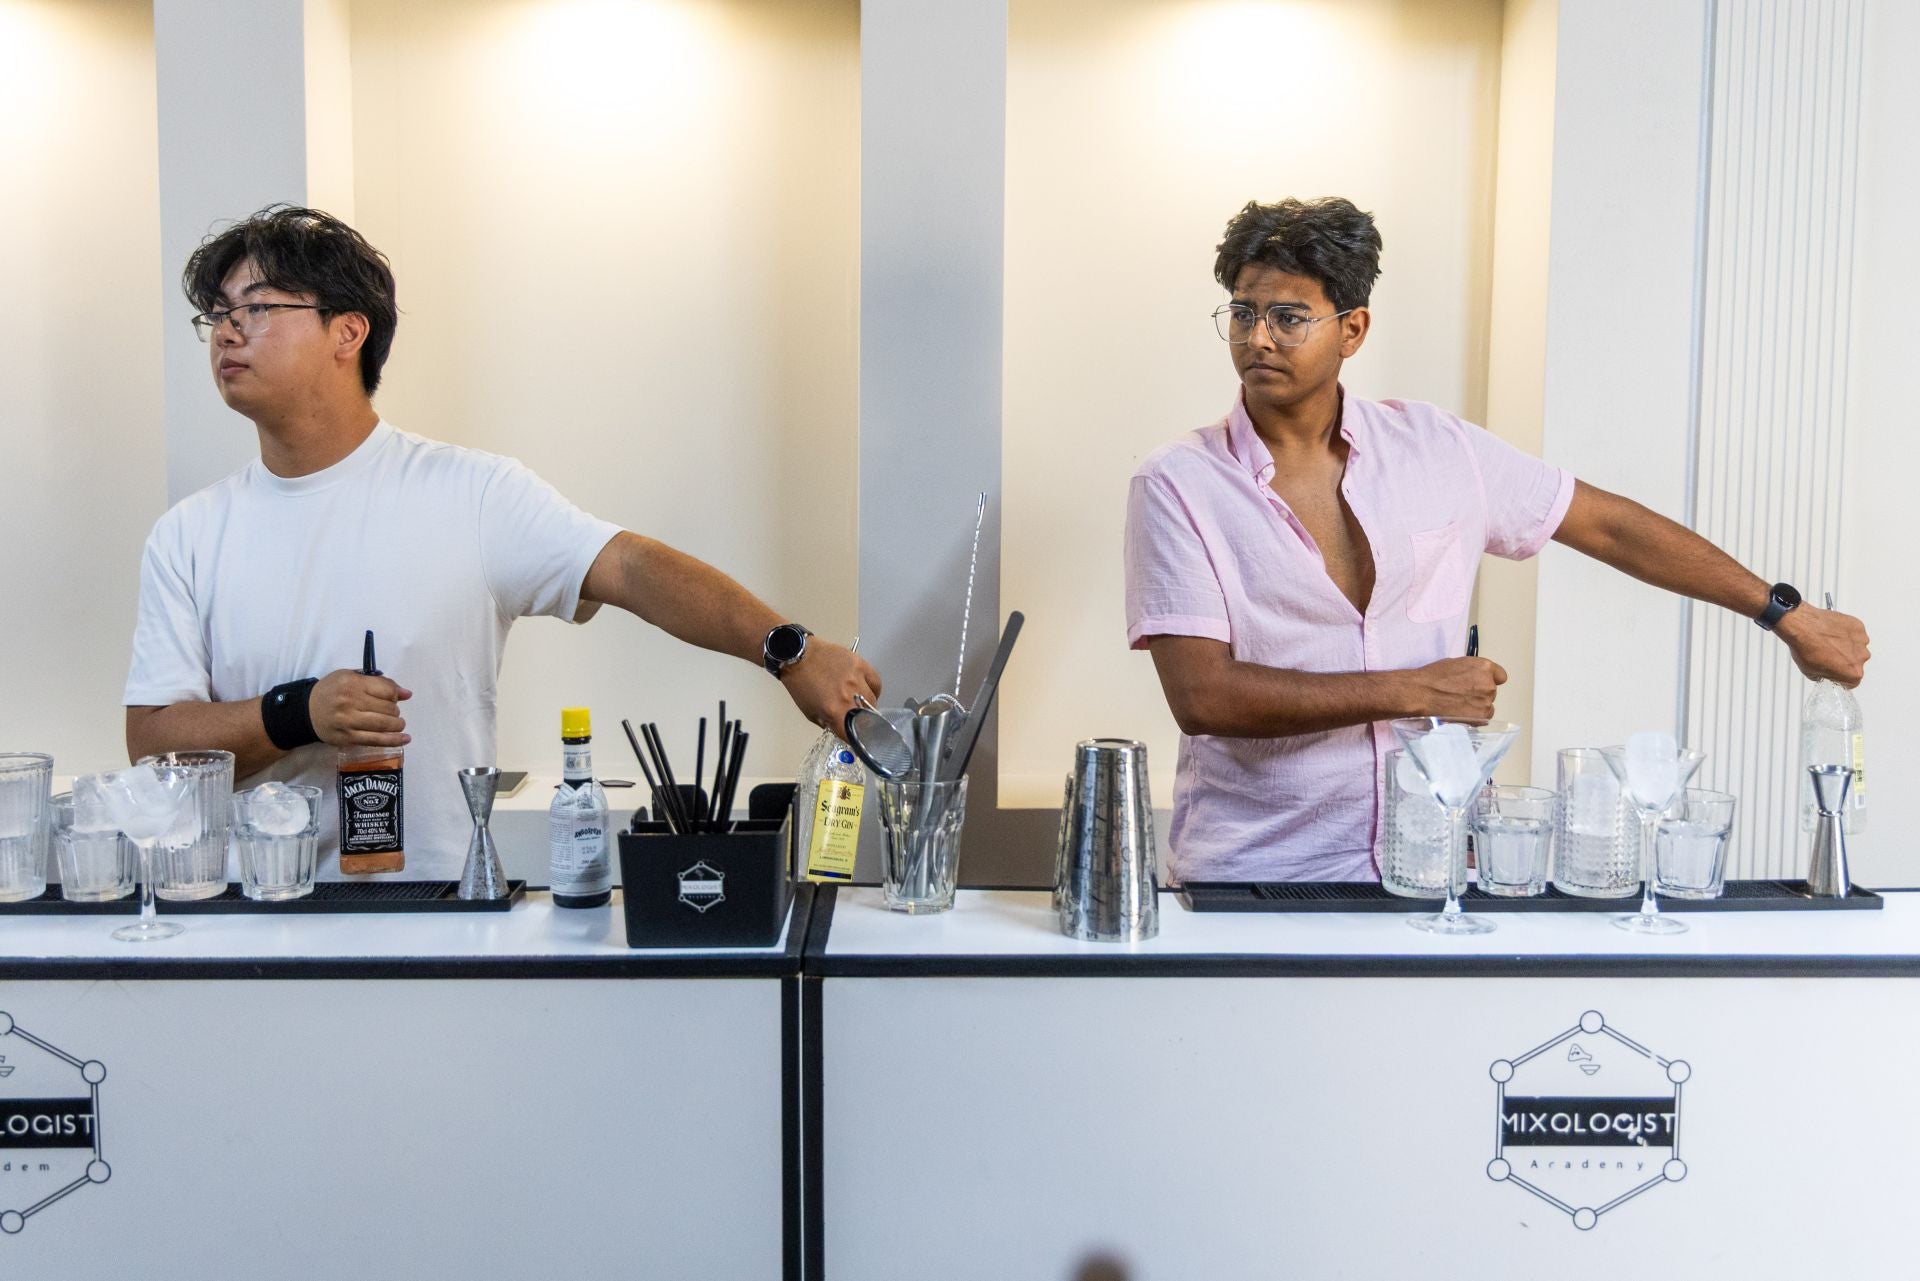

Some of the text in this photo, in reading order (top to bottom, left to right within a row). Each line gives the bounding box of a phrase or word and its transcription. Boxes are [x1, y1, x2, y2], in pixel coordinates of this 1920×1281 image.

[344, 778, 399, 798] JACK DANIEL'S
[353, 811, 390, 819] Tennessee
[821, 800, 860, 817] Seagram's
[824, 817, 853, 829] DRY GIN
[1501, 1112, 1676, 1133] MIXOLOGIST
